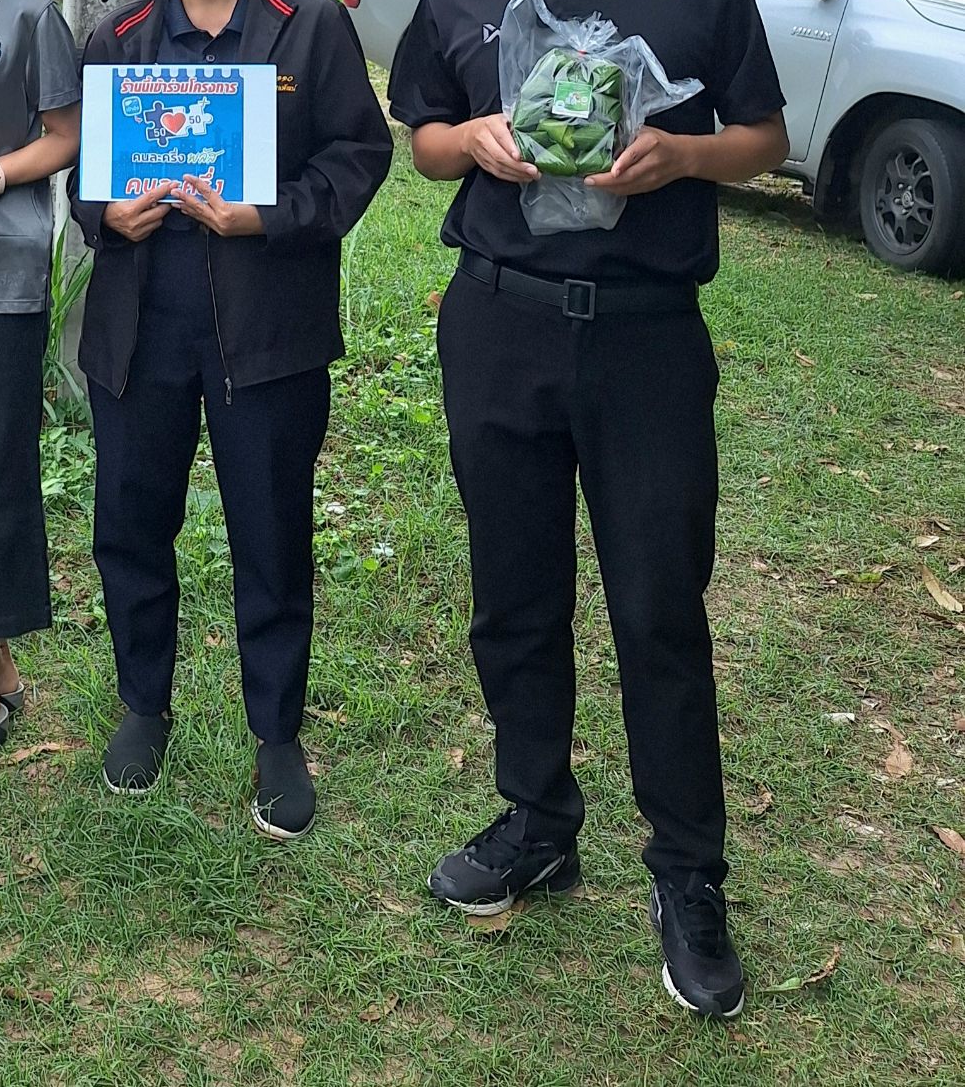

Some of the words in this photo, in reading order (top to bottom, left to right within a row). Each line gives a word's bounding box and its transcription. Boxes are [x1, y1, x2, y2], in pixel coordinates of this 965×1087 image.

[121, 74, 237, 94] ร้านนี้เข้าร่วมโครงการ
[188, 115, 202, 124] 50
[153, 128, 166, 138] 50
[132, 147, 186, 163] คนละครึ่ง
